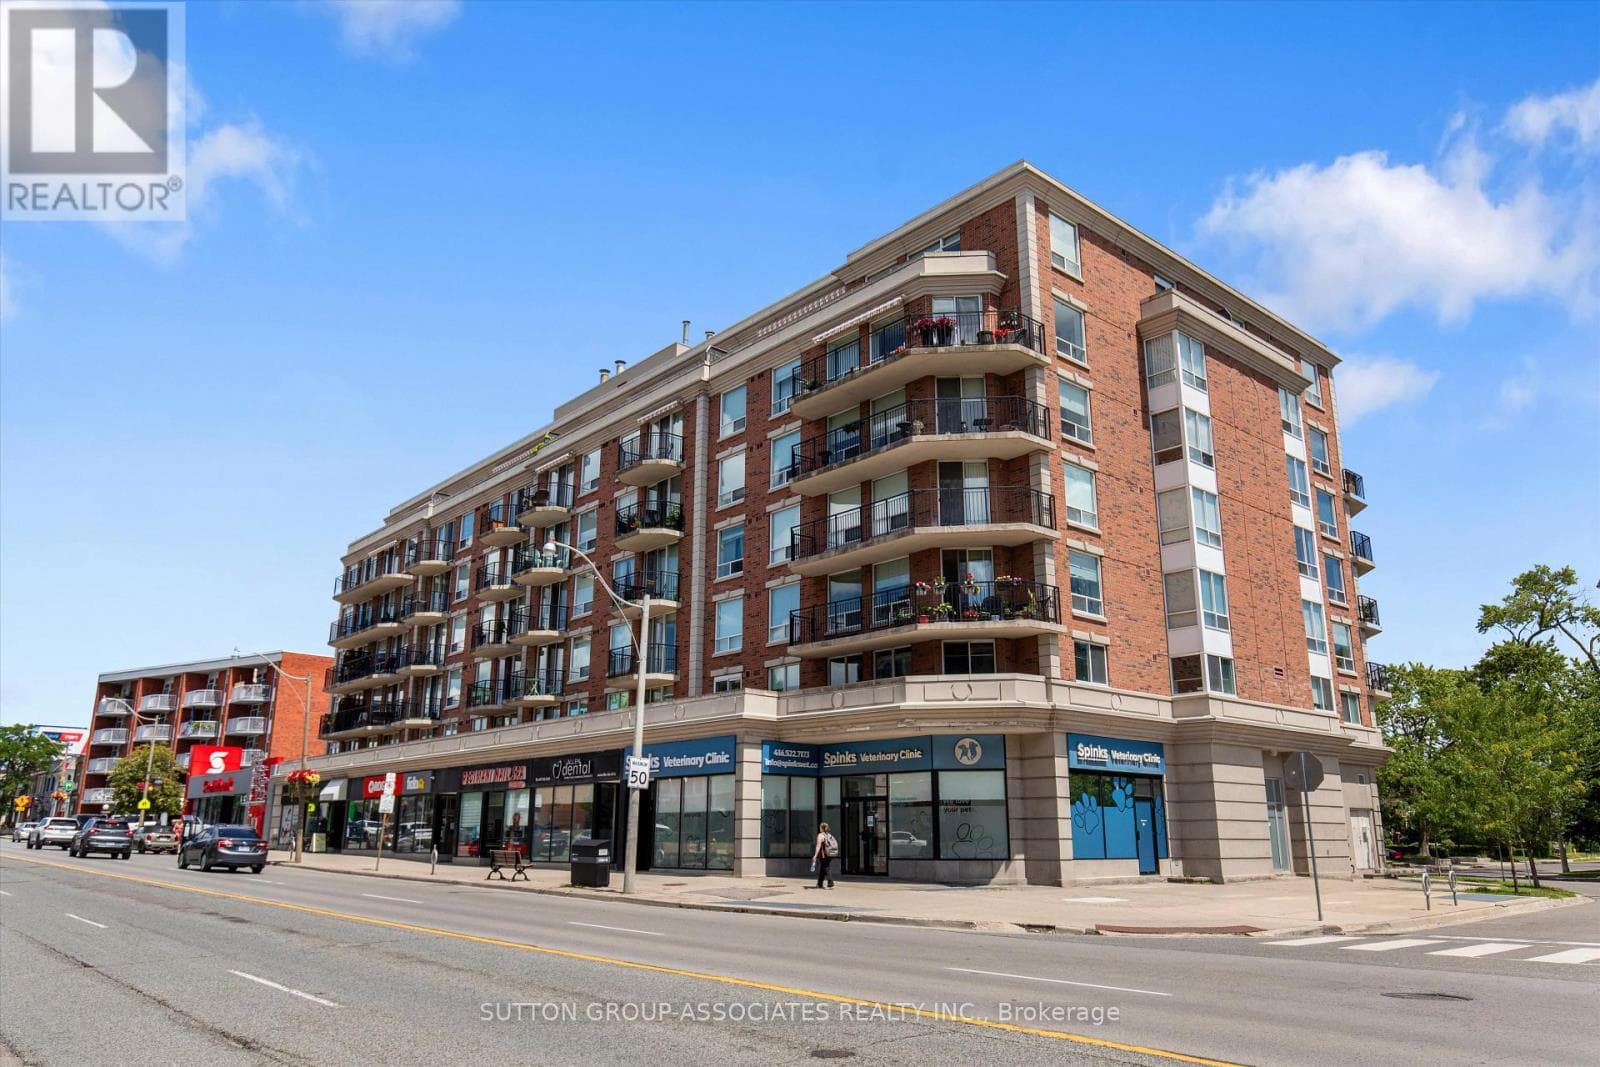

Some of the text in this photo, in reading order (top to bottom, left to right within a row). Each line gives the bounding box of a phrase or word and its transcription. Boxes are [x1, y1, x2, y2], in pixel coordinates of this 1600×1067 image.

[663, 755, 705, 768] Veterinary
[705, 752, 730, 764] Clinic
[824, 749, 922, 766] Spinks Veterinary Clinic
[1077, 743, 1161, 763] Spinks Veterinary Clinic
[562, 760, 591, 776] dental
[630, 770, 647, 785] 50
